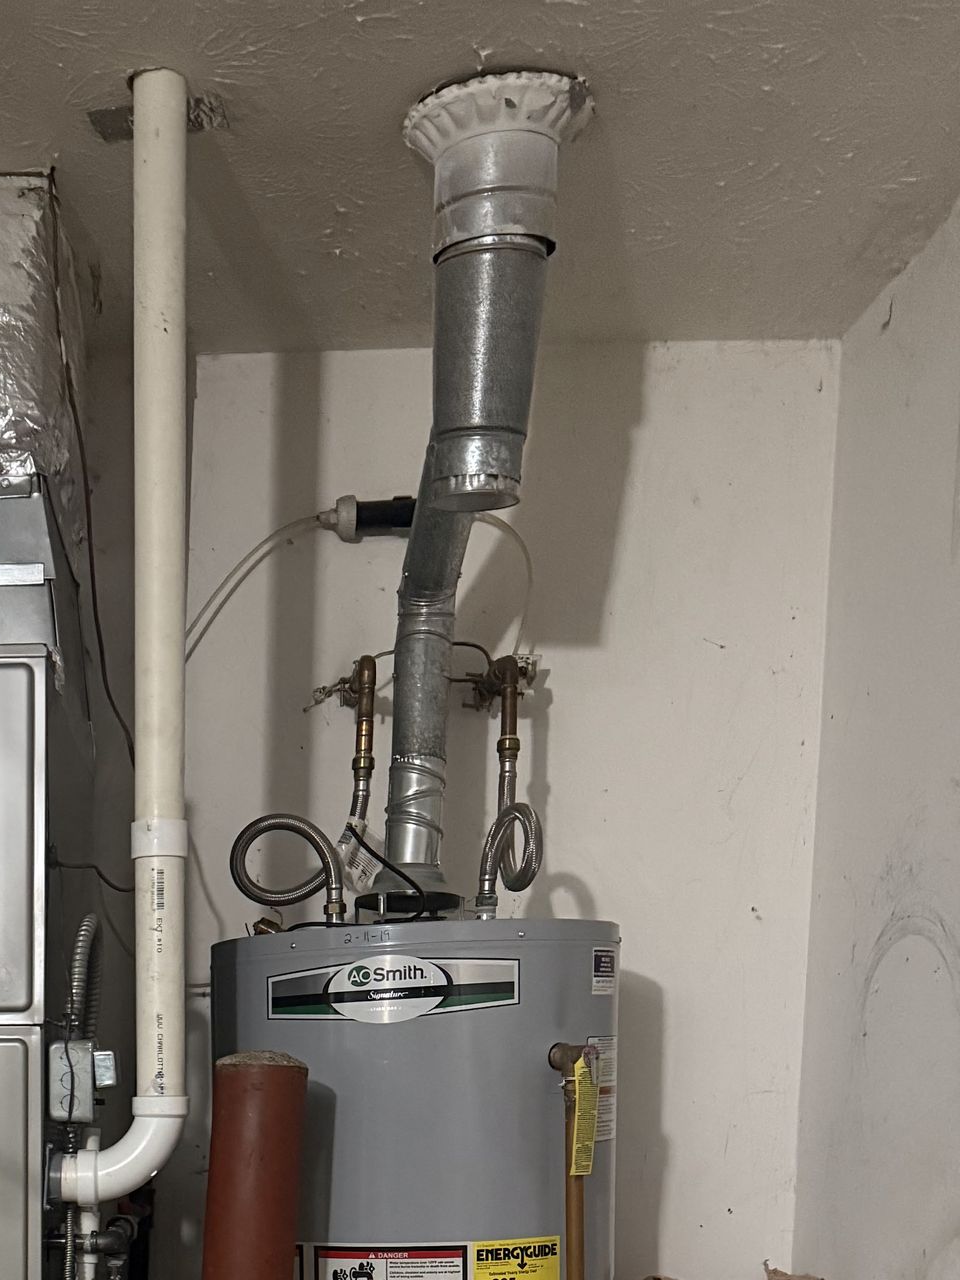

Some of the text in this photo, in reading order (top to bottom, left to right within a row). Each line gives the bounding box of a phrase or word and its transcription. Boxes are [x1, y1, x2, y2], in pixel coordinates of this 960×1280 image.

[344, 929, 391, 944] 2-11-19
[368, 989, 408, 1001] Signature
[477, 1243, 557, 1262] ENERGYGUIDE
